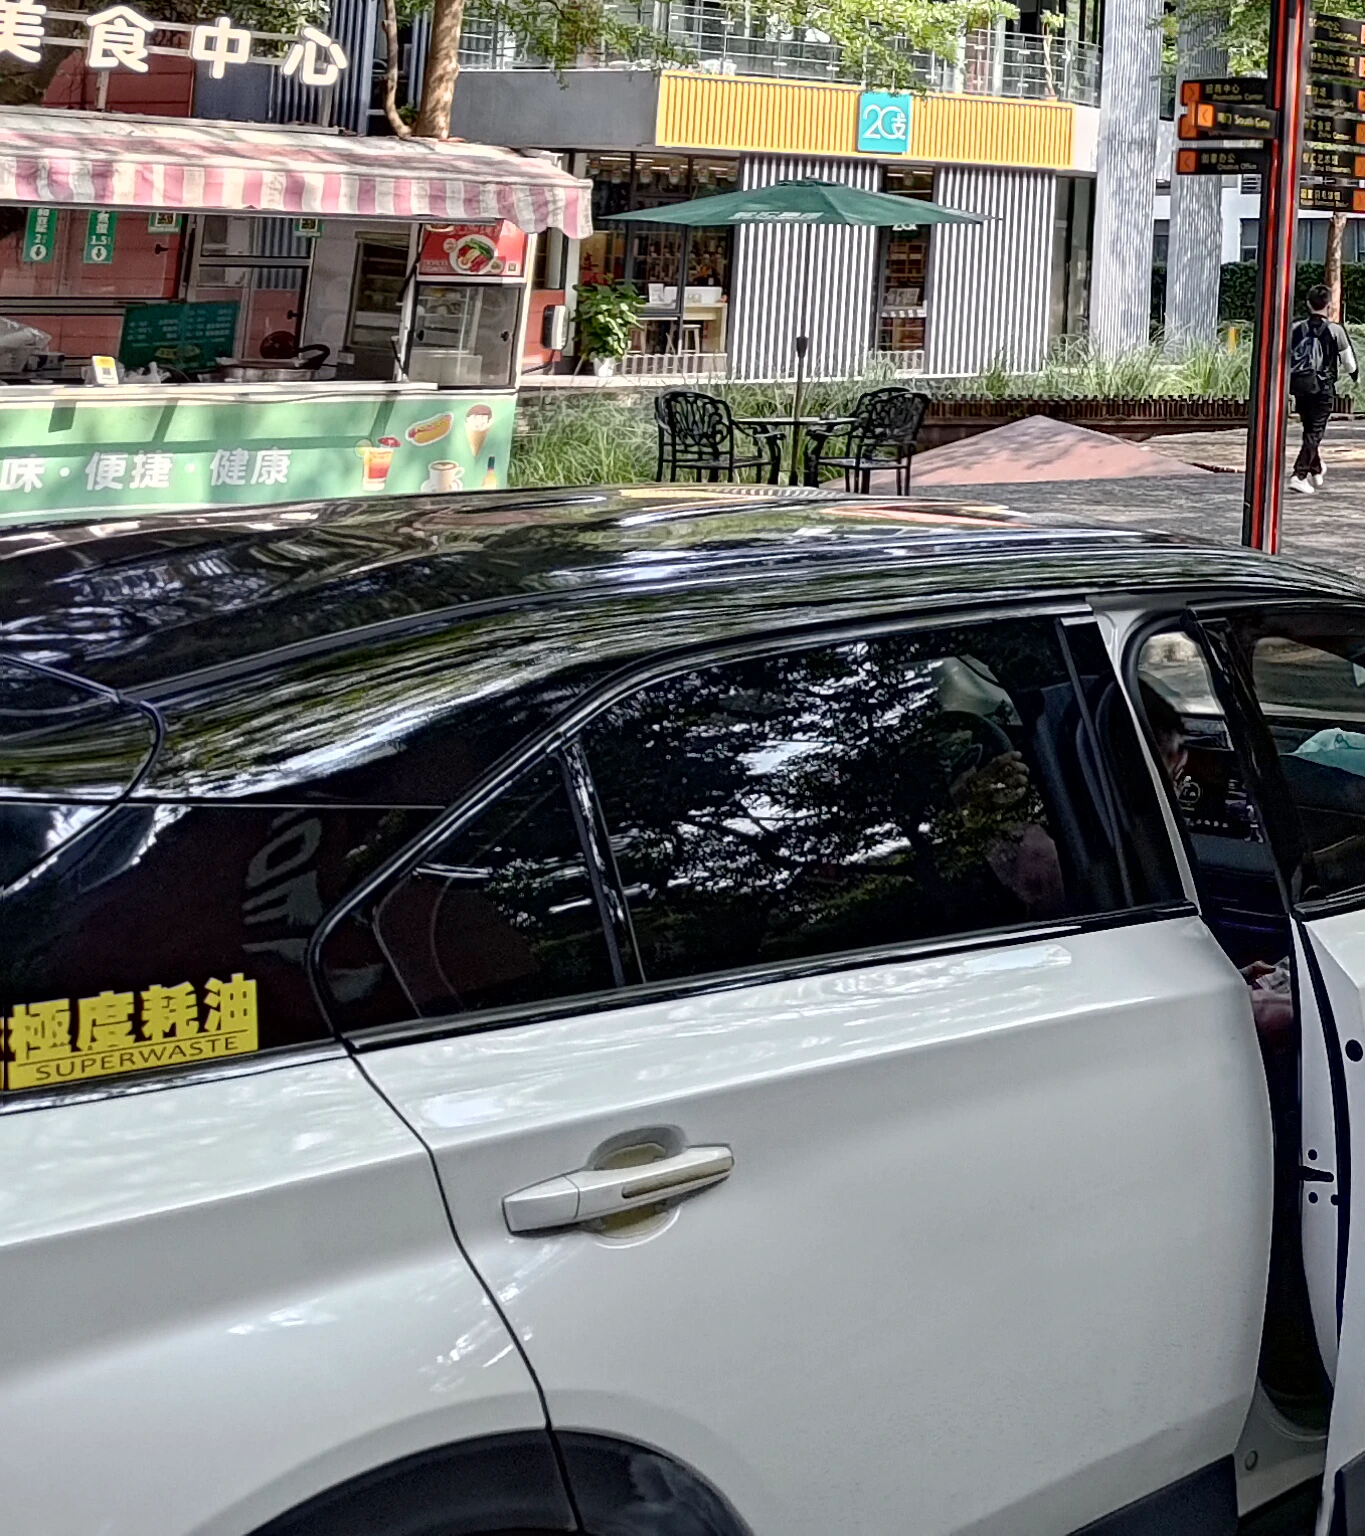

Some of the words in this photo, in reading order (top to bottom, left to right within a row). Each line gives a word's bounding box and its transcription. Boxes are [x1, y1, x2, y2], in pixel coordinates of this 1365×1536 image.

[1234, 114, 1255, 127] South
[1255, 117, 1271, 130] Gate
[35, 1035, 239, 1082] SUPERWASTE
